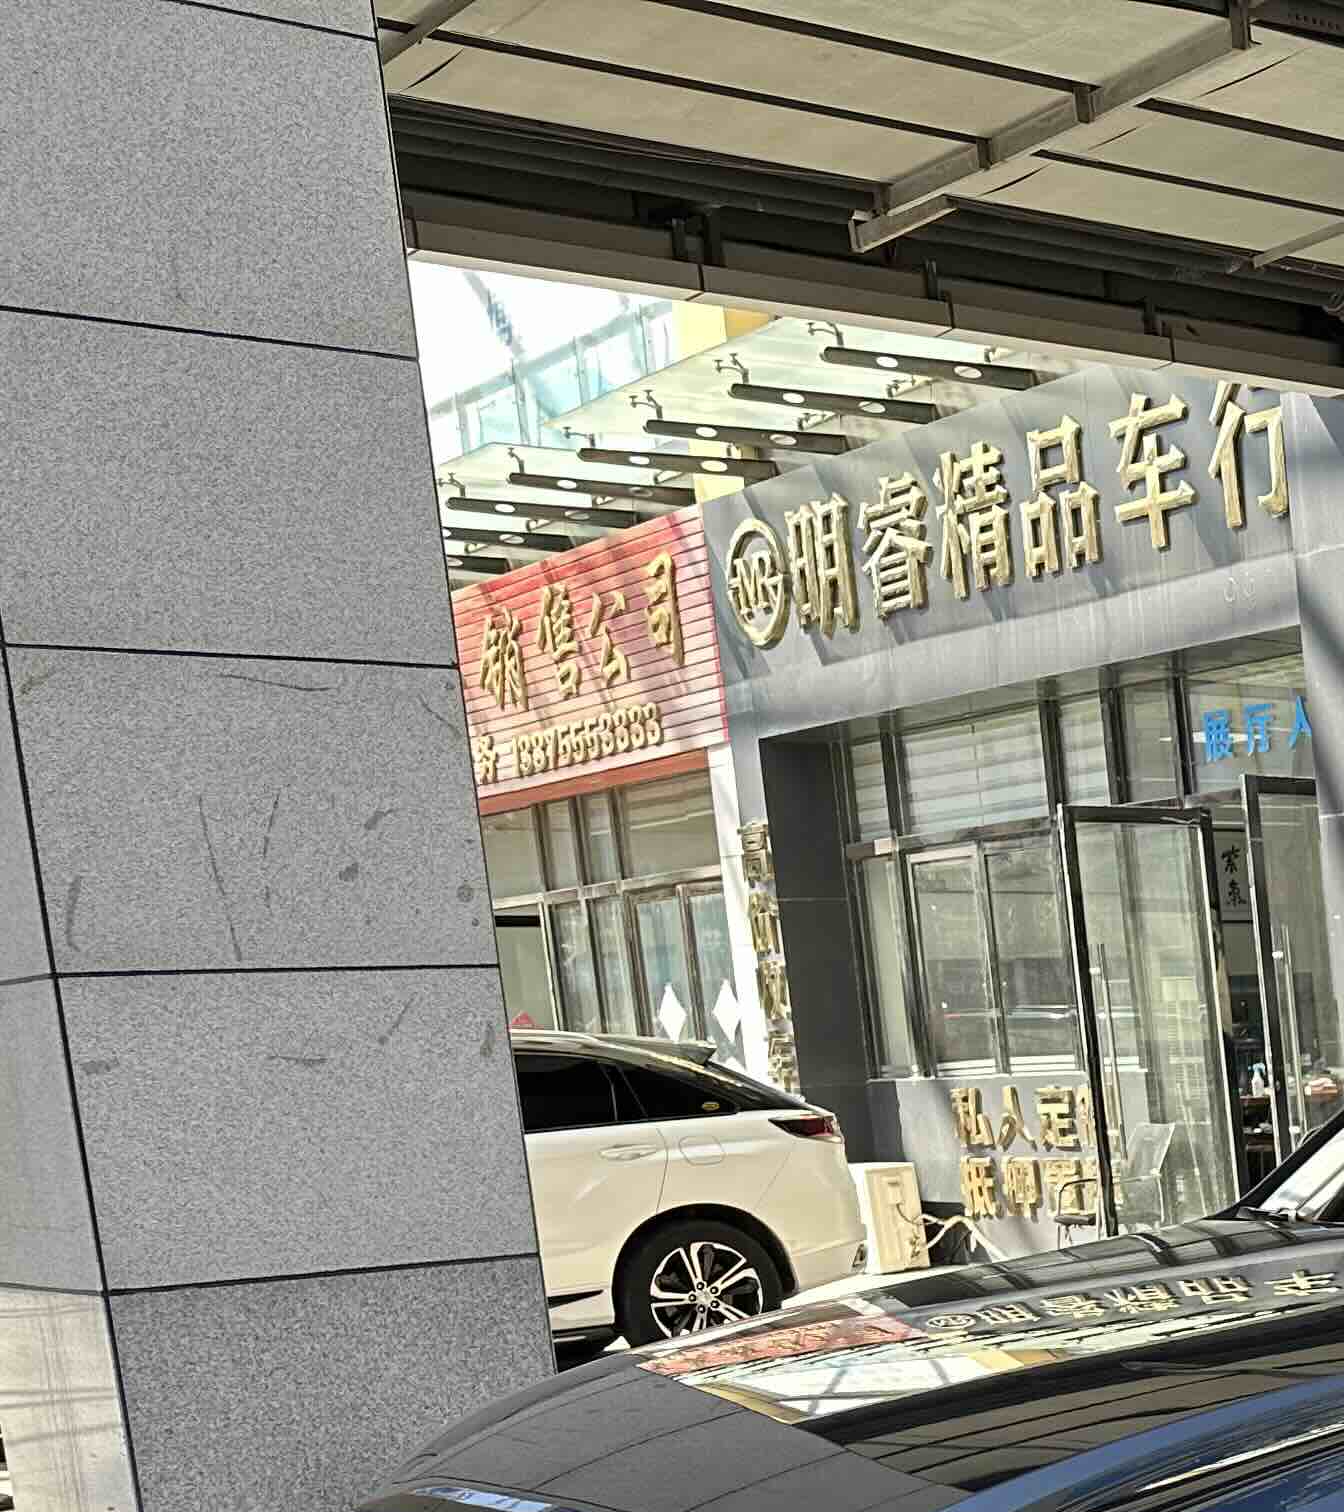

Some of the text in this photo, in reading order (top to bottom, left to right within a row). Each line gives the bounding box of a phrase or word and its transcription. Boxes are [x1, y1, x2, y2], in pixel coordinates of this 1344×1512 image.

[785, 384, 1290, 638] 明睿精品车行
